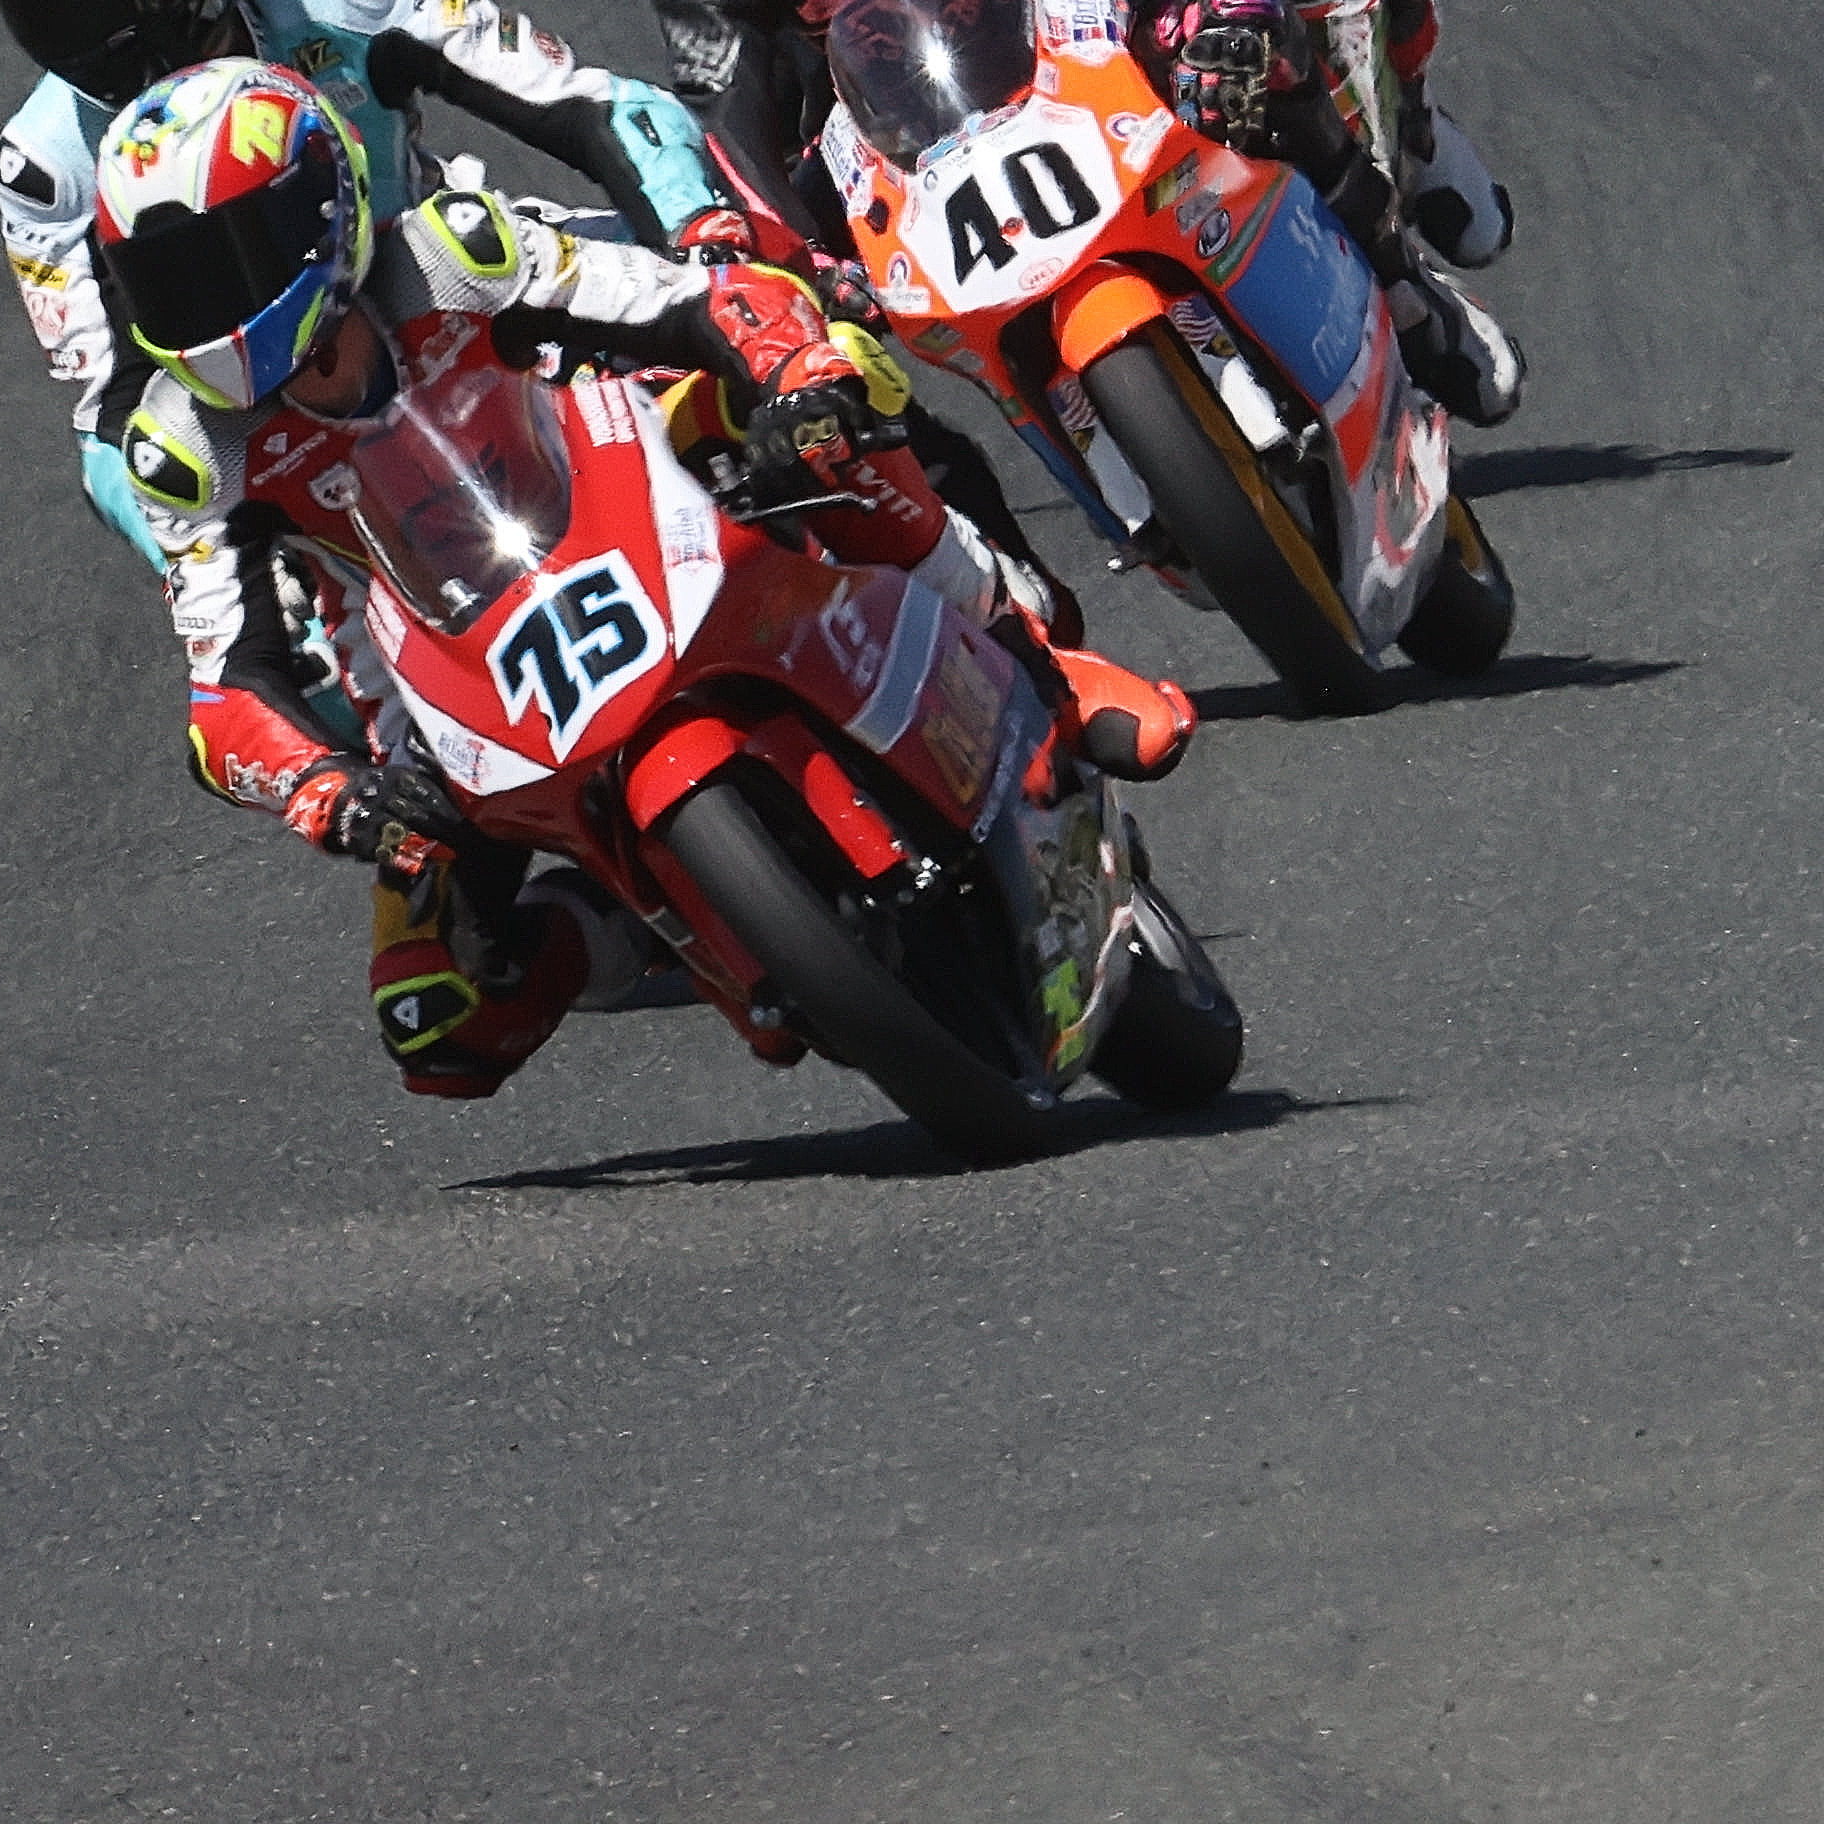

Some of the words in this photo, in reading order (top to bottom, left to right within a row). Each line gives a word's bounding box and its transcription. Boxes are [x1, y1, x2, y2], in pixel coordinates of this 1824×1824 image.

[231, 97, 286, 166] 75
[944, 142, 1101, 286] 40
[497, 567, 648, 730] 75
